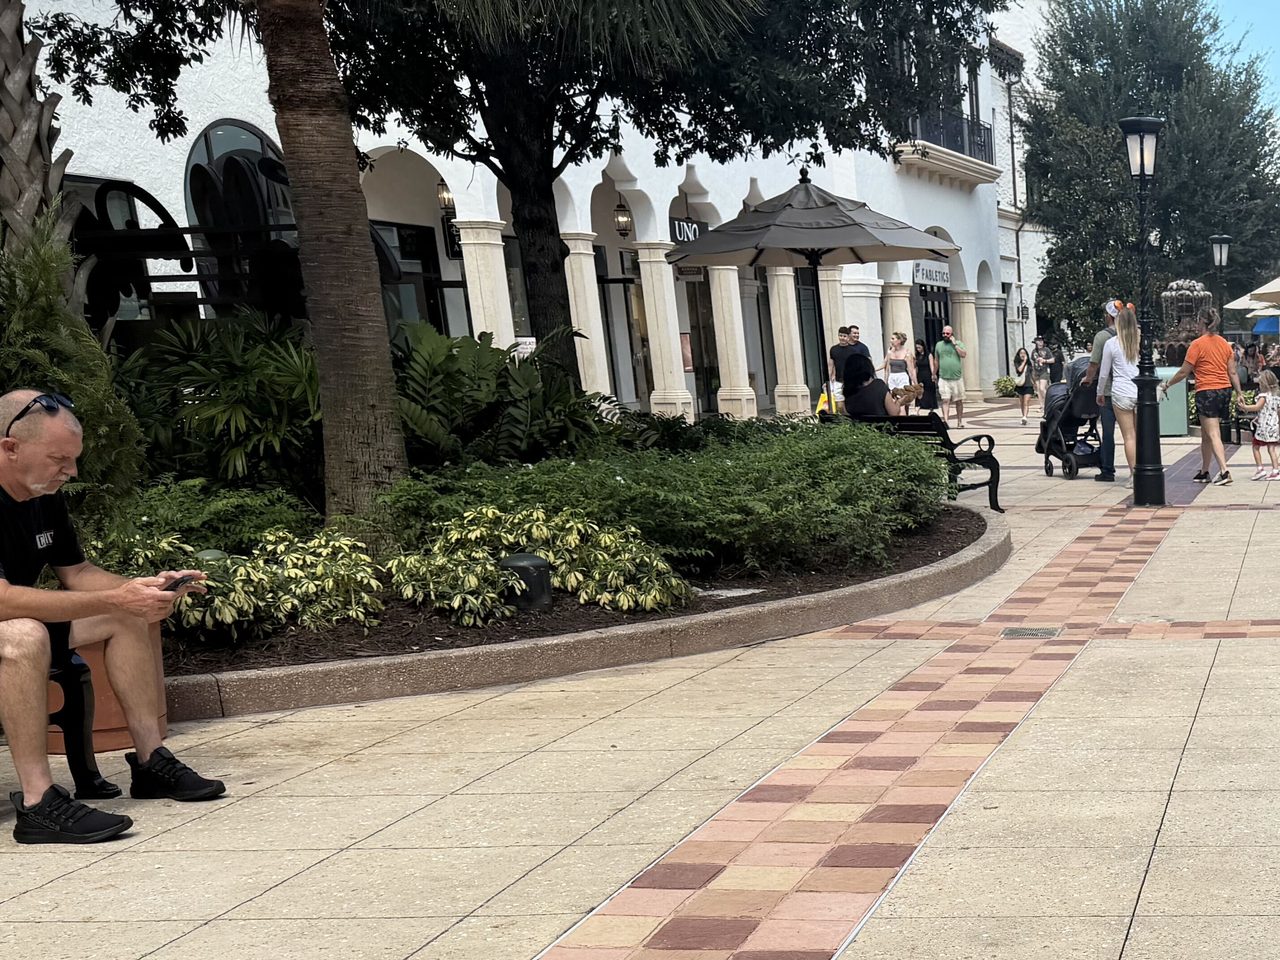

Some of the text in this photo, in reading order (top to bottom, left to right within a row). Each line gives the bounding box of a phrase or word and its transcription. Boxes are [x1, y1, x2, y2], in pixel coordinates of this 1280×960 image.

[674, 220, 699, 241] UNO
[921, 267, 949, 283] FABLETICS
[28, 812, 60, 831] adidas
